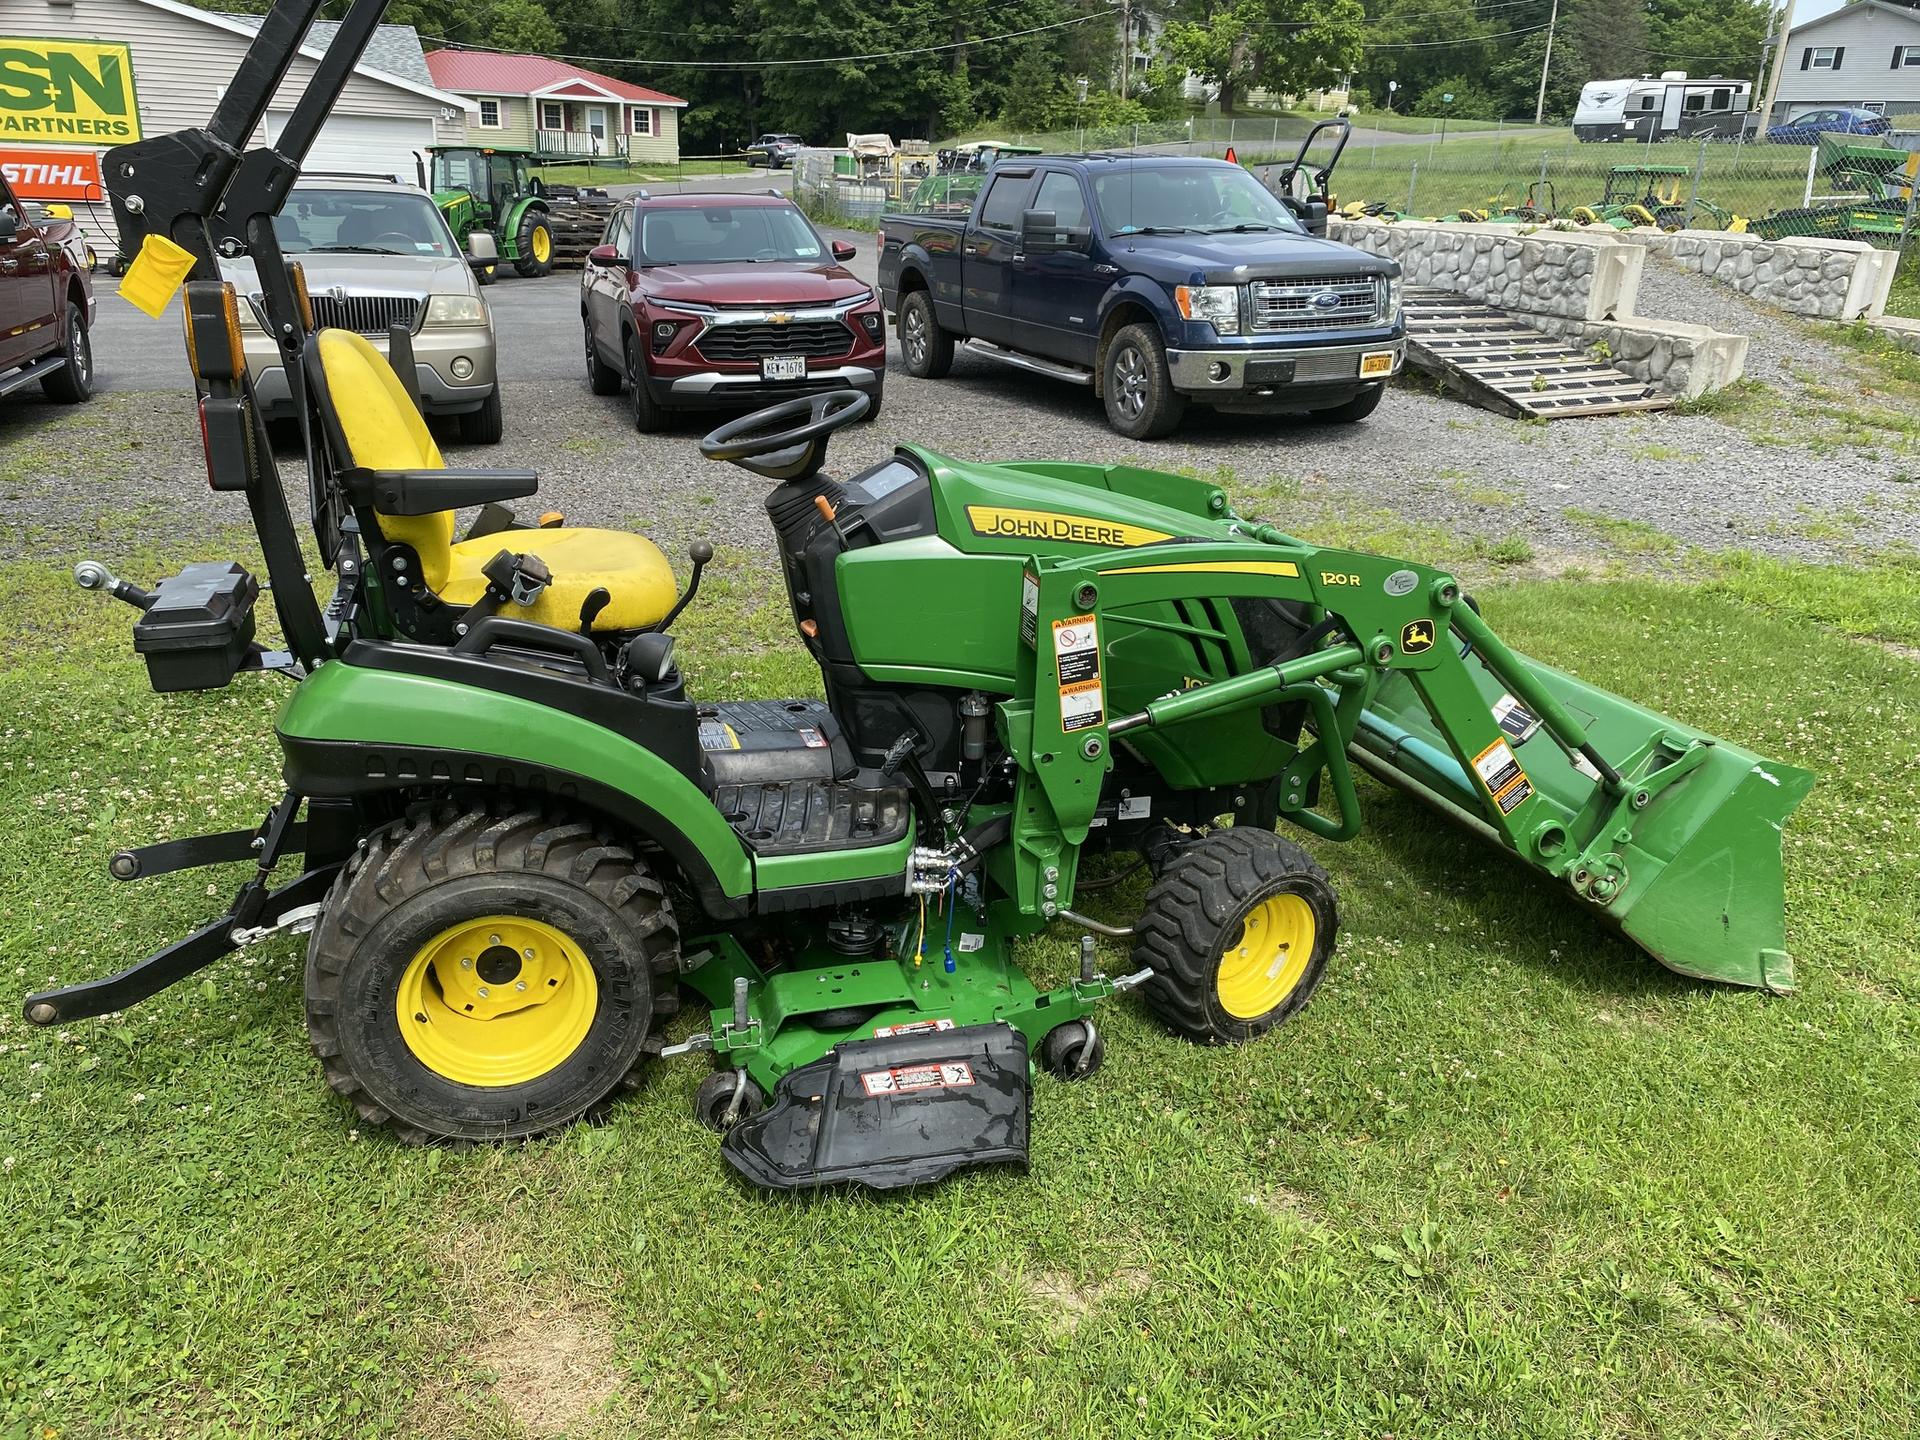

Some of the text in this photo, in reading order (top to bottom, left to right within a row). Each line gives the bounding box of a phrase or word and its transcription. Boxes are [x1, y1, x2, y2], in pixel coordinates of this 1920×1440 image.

[0, 116, 130, 136] ARTNERS
[1, 163, 93, 186] STIHL
[988, 515, 1125, 544] JOHN DEERE
[1321, 572, 1360, 587] 120 R
[1061, 615, 1094, 627] WARNING
[1067, 681, 1100, 694] WARNING
